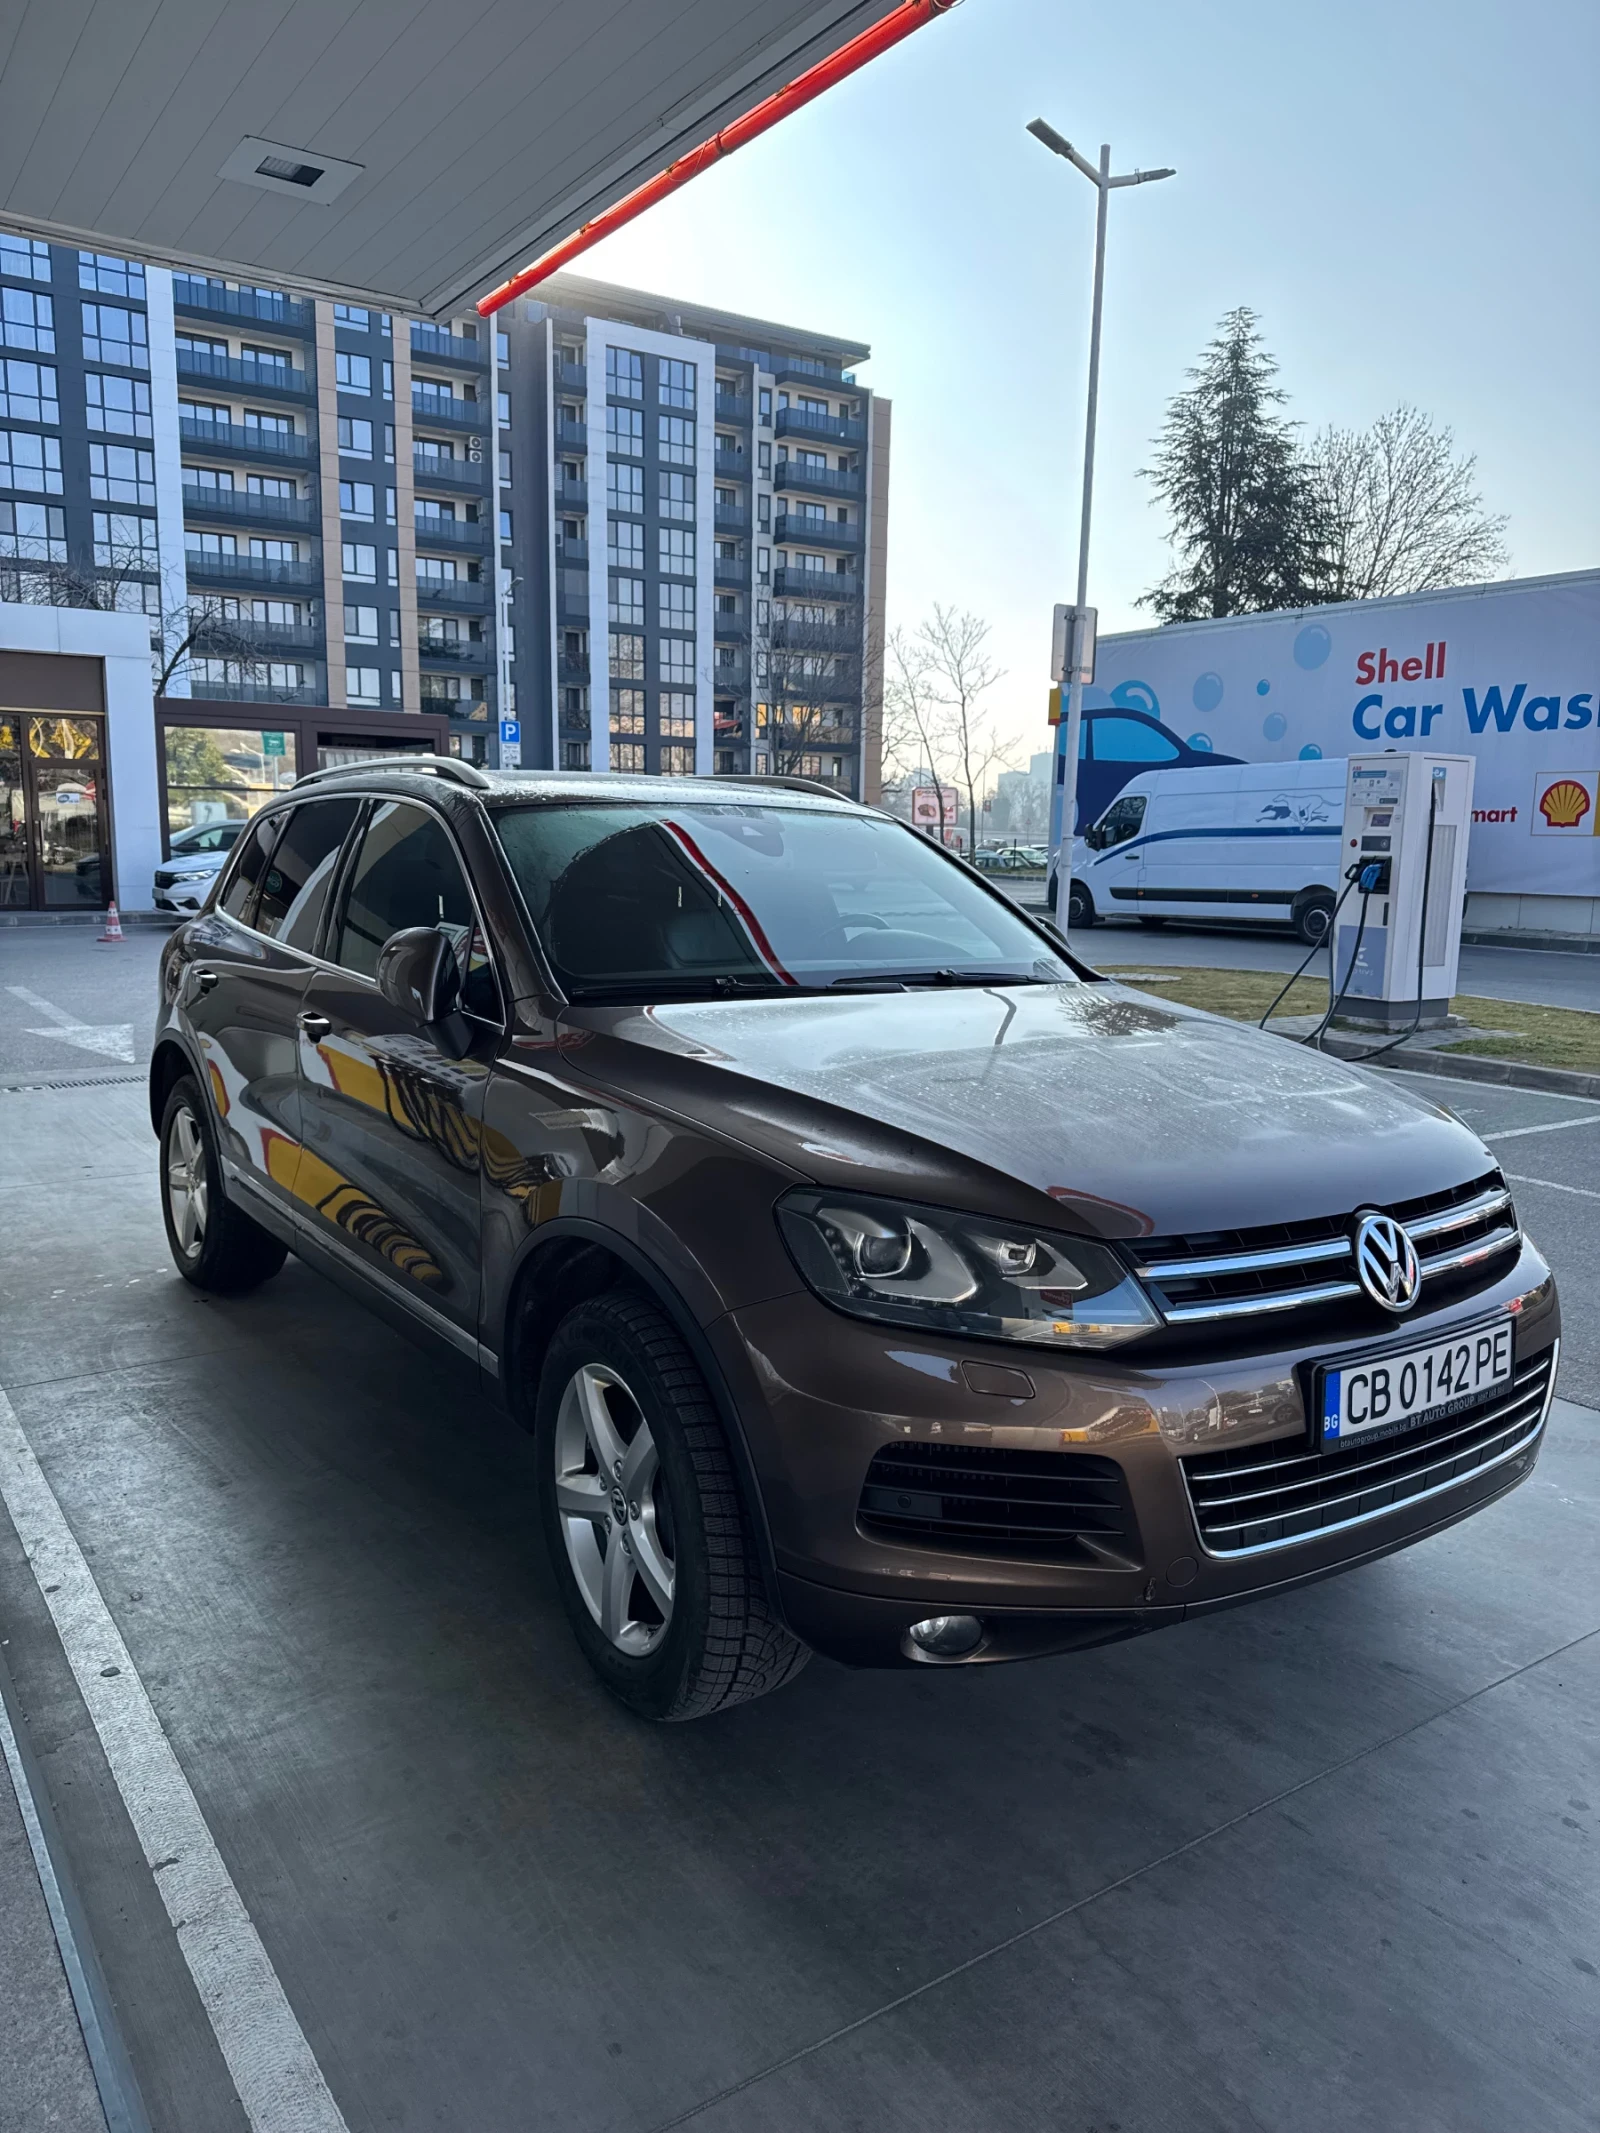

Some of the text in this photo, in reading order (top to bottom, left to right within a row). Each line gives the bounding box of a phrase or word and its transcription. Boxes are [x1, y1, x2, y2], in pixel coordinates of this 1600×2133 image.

[1355, 641, 1447, 685] Shell
[1352, 683, 1600, 740] Car Was
[505, 724, 517, 740] P
[1347, 1330, 1509, 1425] CB 0142 PE
[1324, 1414, 1339, 1432] BG
[1410, 1414, 1422, 1428] BT
[1422, 1406, 1446, 1424] AUTO
[1447, 1395, 1475, 1414] GROUP
